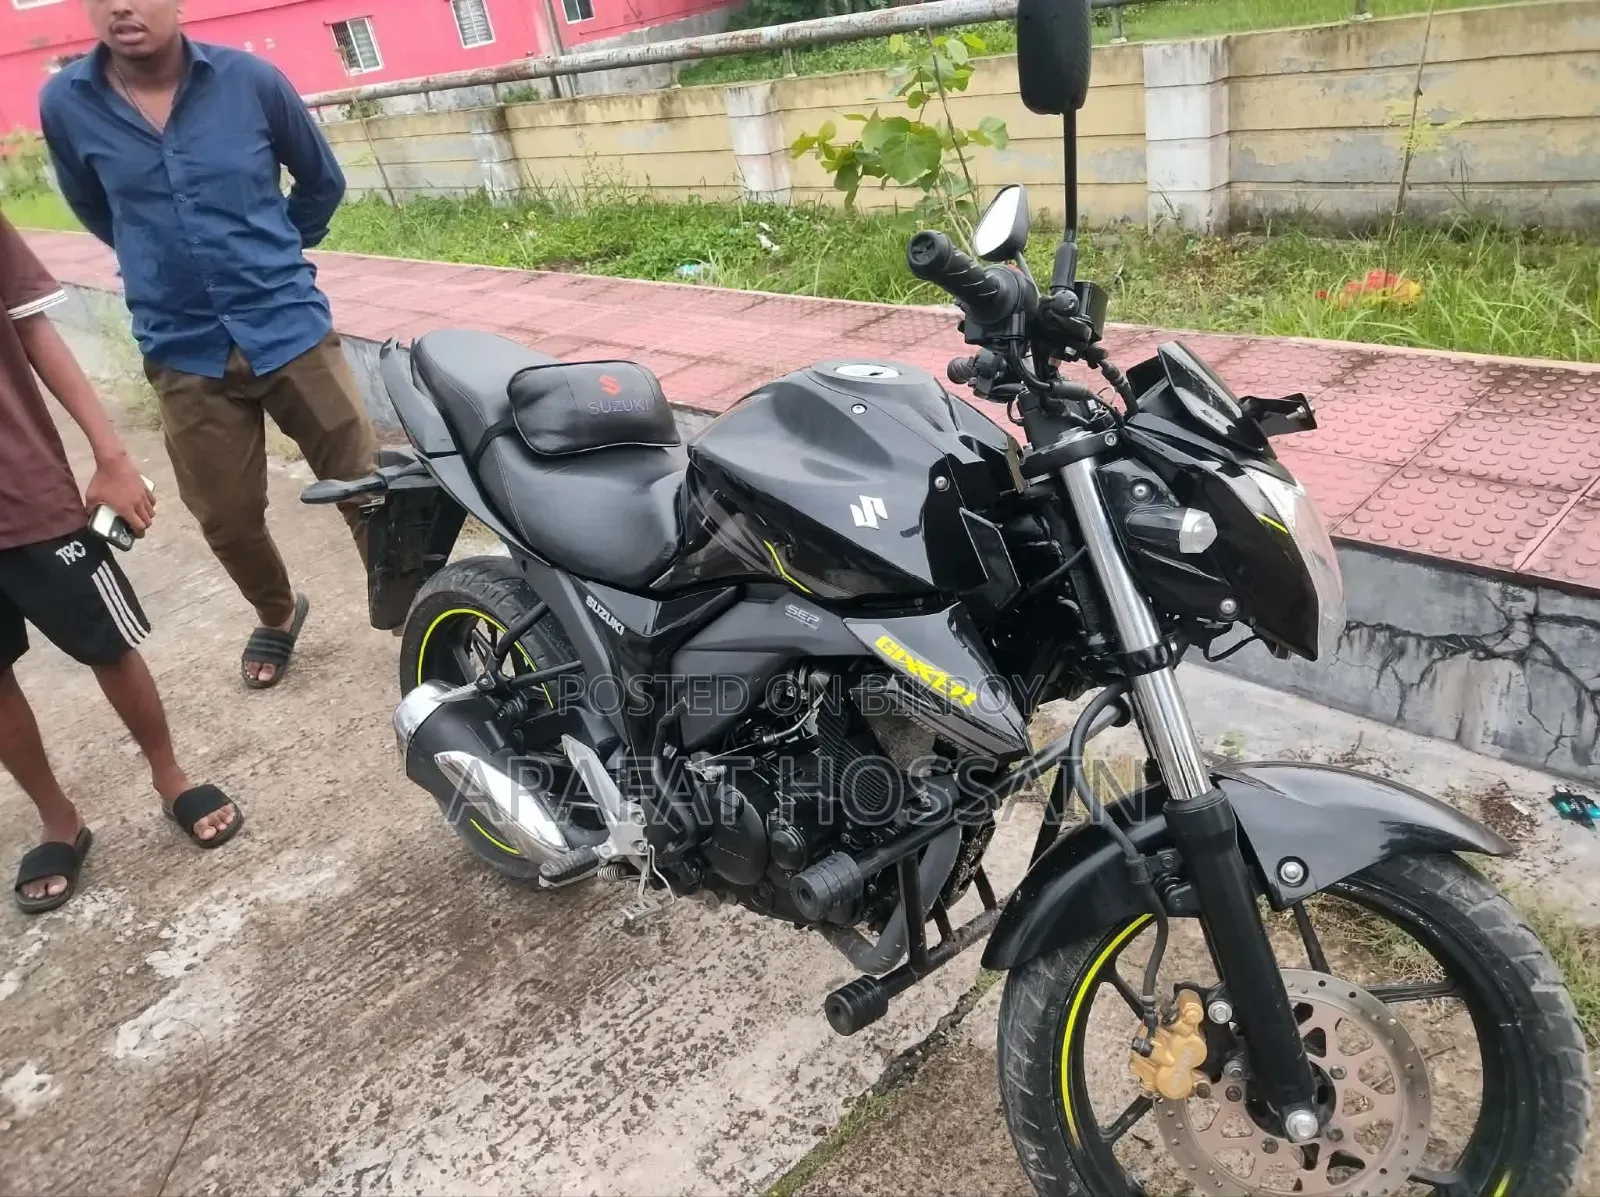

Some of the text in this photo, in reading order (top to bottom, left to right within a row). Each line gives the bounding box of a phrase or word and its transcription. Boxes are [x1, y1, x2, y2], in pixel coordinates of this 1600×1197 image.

[587, 399, 651, 414] SUZUKI
[586, 595, 625, 636] SUZUKI
[786, 604, 820, 622] SEP
